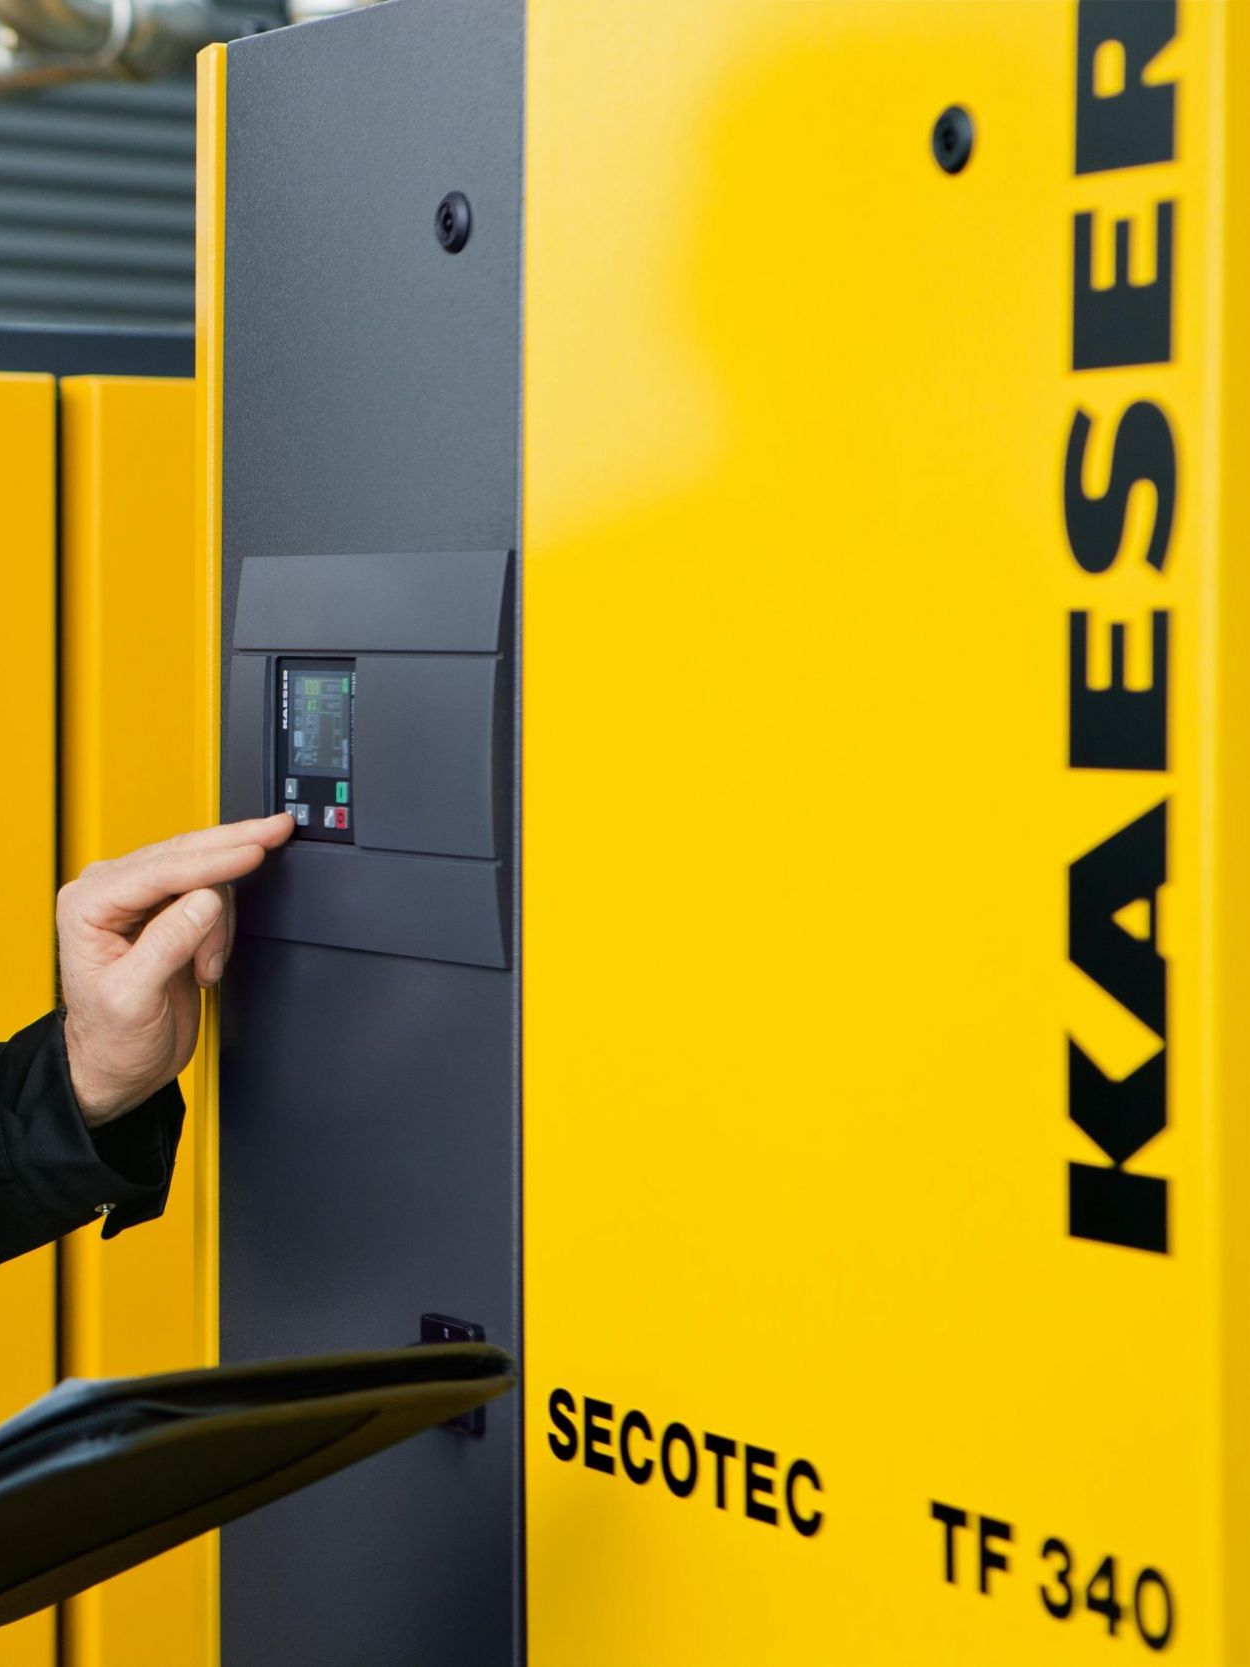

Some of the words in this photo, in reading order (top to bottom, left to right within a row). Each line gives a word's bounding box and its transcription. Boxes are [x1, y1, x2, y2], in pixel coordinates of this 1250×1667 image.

[1064, 0, 1178, 1255] KAESER
[547, 1387, 824, 1538] SECOTEC
[930, 1500, 1013, 1595] TF
[1040, 1537, 1174, 1652] 340
